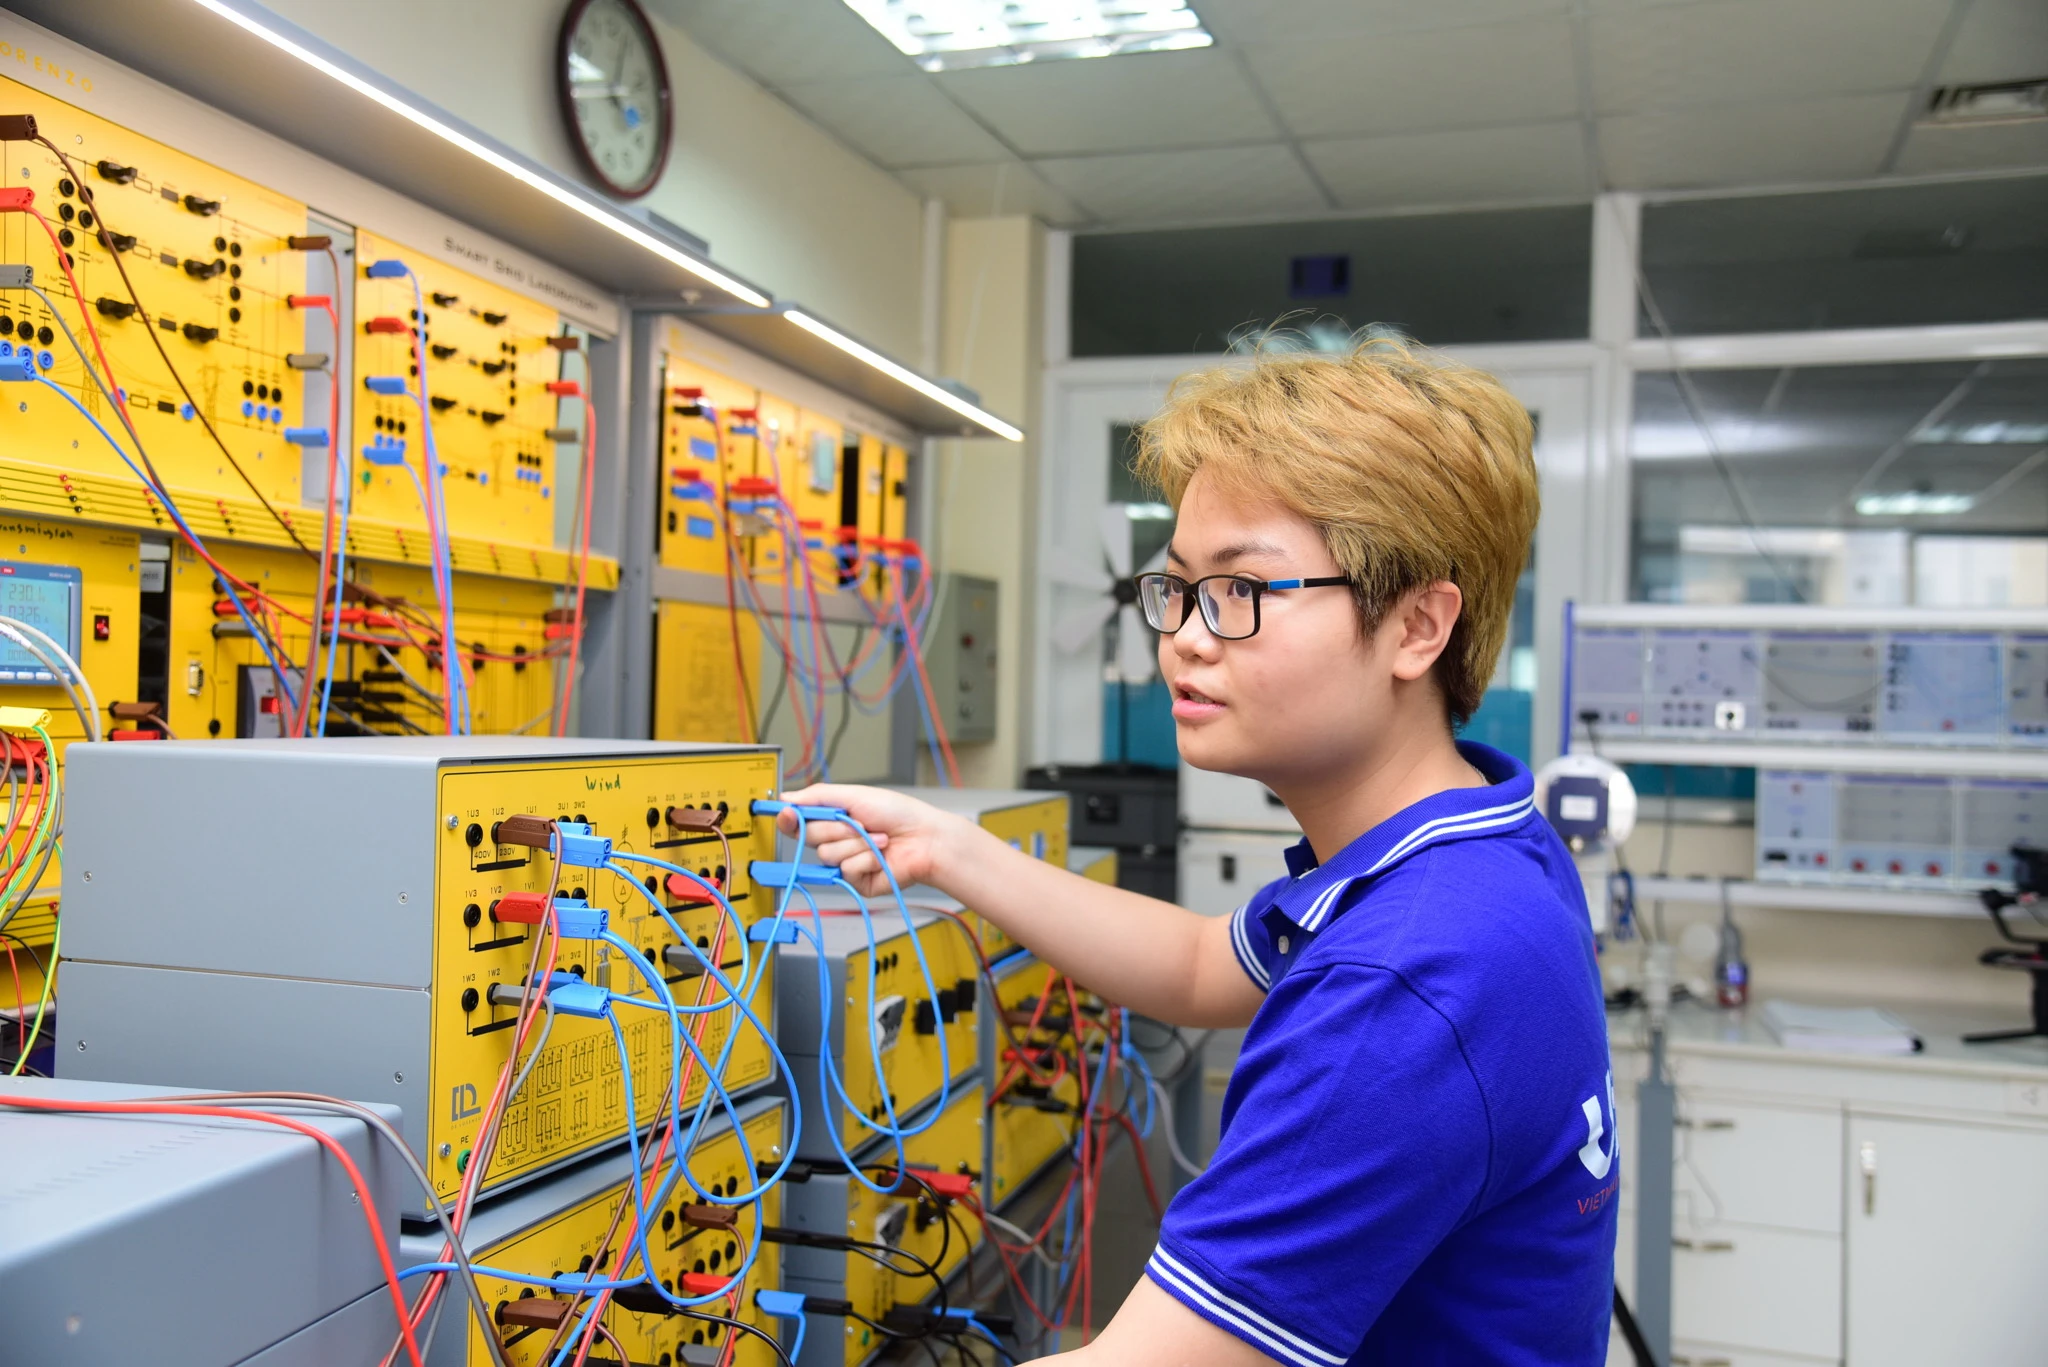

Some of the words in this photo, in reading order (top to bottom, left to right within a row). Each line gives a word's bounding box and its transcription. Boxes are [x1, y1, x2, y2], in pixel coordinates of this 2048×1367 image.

[0, 41, 94, 93] ORENZO
[585, 774, 621, 791] Wind
[467, 809, 480, 818] 1U3
[492, 807, 505, 816] 1U2
[526, 805, 537, 814] 1U1
[558, 802, 569, 810] 3U1
[574, 801, 586, 809] 3W2
[473, 850, 491, 859] 400V
[499, 847, 516, 857] 230V
[571, 874, 583, 883] 3U2
[465, 889, 478, 898] 1V3
[490, 885, 502, 894] 1V2
[524, 881, 535, 890] 1V1
[570, 950, 581, 960] 3V2
[462, 974, 476, 983] 1W3
[488, 968, 501, 977] 1W2
[521, 963, 531, 971] 1W
[460, 1135, 469, 1144] PE
